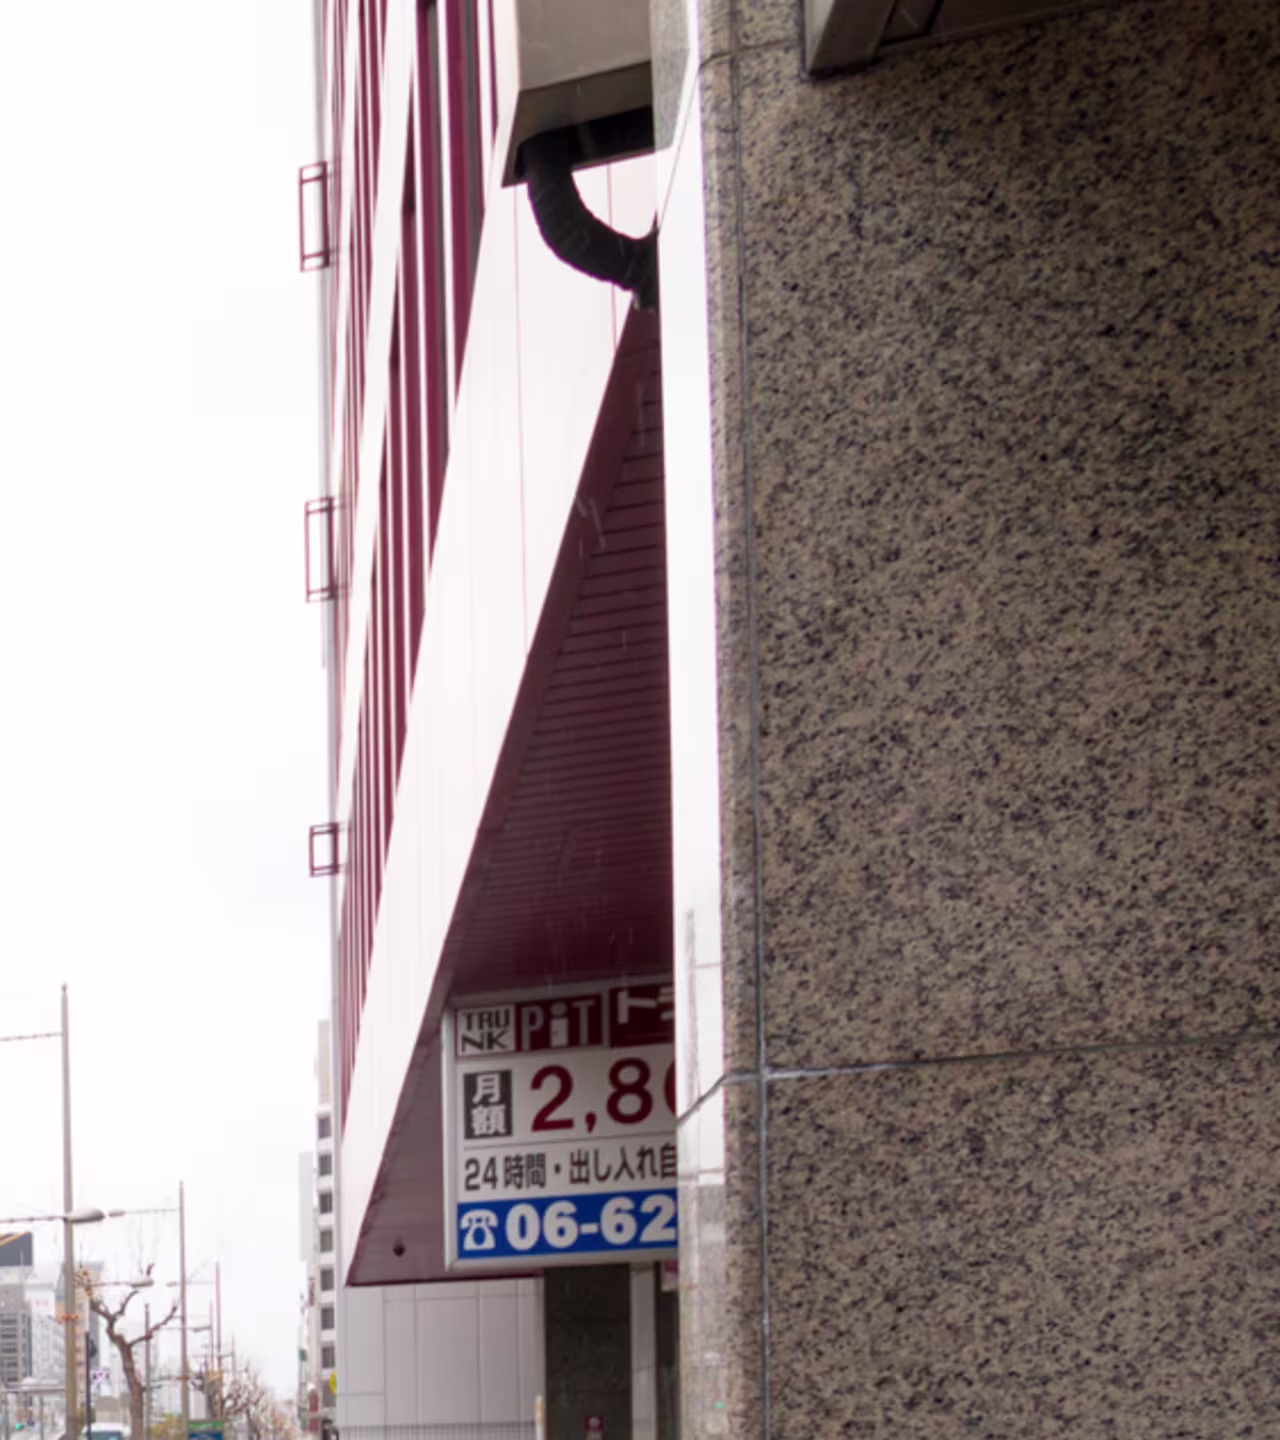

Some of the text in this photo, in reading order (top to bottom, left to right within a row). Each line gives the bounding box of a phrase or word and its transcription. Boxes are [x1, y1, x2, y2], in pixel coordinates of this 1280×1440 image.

[463, 1008, 510, 1031] TRU
[461, 1030, 508, 1052] NK
[471, 1073, 507, 1137] 月額
[505, 1194, 675, 1251] 06-62
